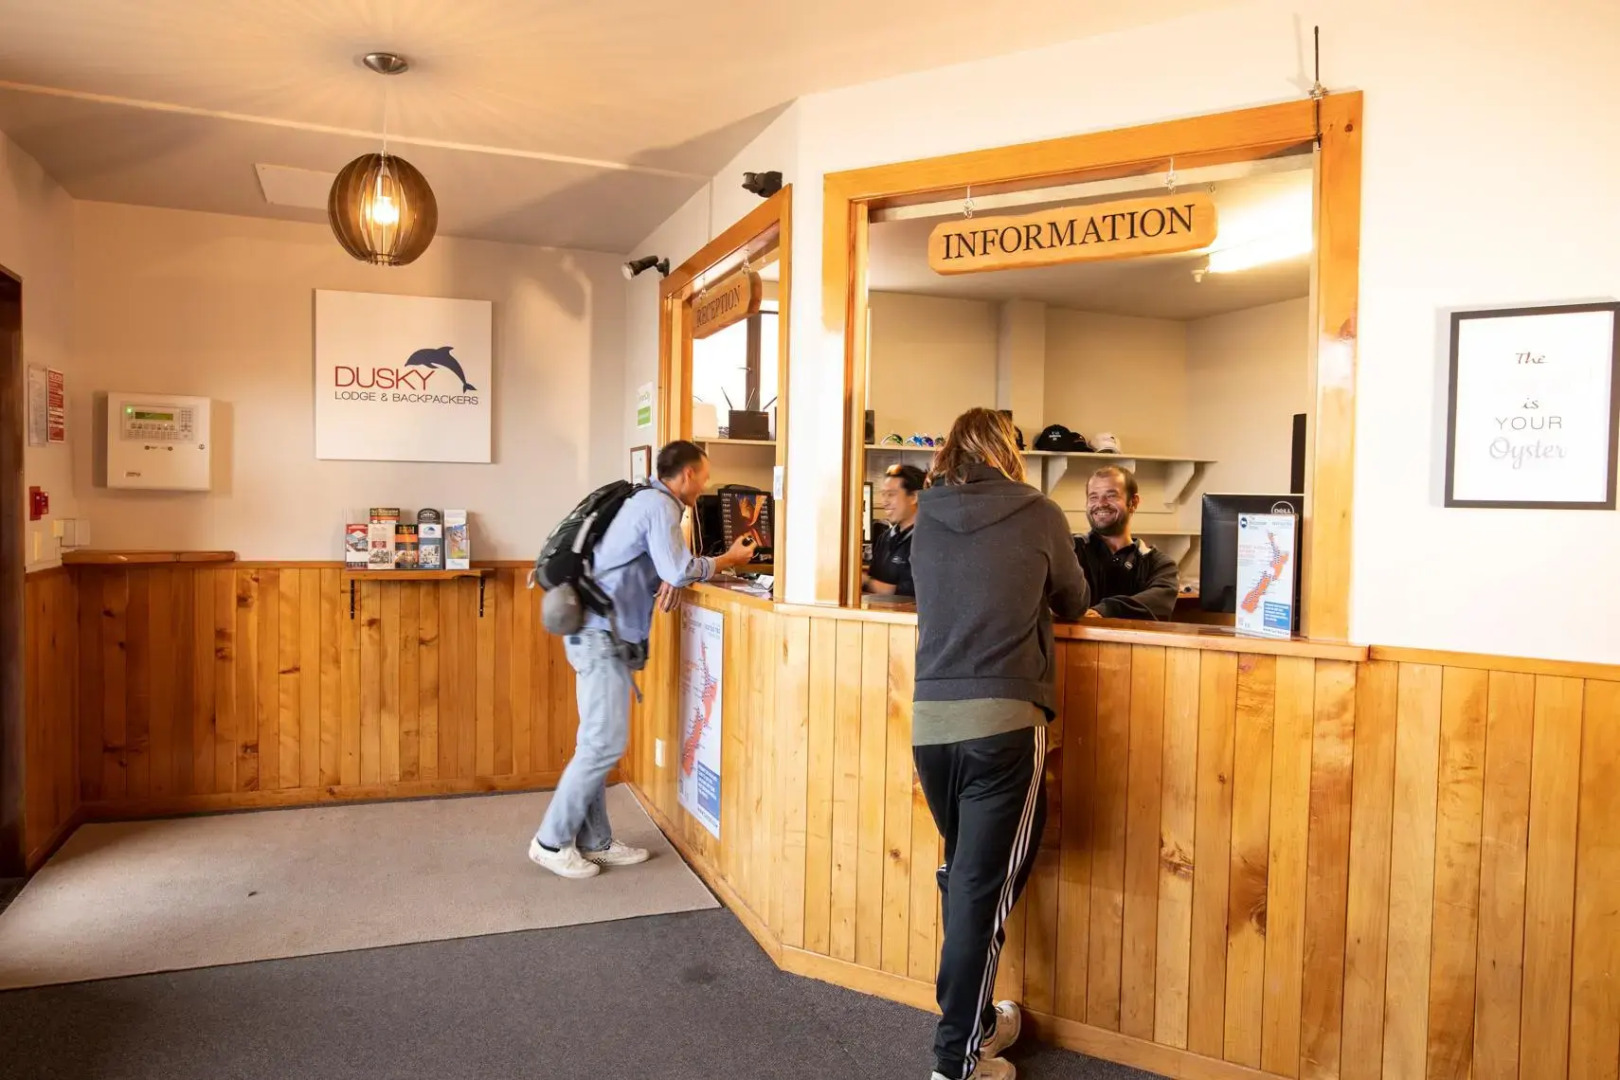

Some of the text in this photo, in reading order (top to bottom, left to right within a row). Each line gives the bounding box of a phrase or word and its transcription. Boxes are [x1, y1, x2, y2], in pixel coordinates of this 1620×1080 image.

[941, 203, 1196, 260] INFORMATION
[696, 284, 741, 328] RECEPTION
[1515, 351, 1549, 364] The
[334, 365, 435, 391] DUSKY
[334, 391, 479, 406] LODGE & BACKPACKERS
[1522, 397, 1540, 410] is
[1495, 415, 1563, 431] YOUR
[1488, 436, 1567, 470] Oyster
